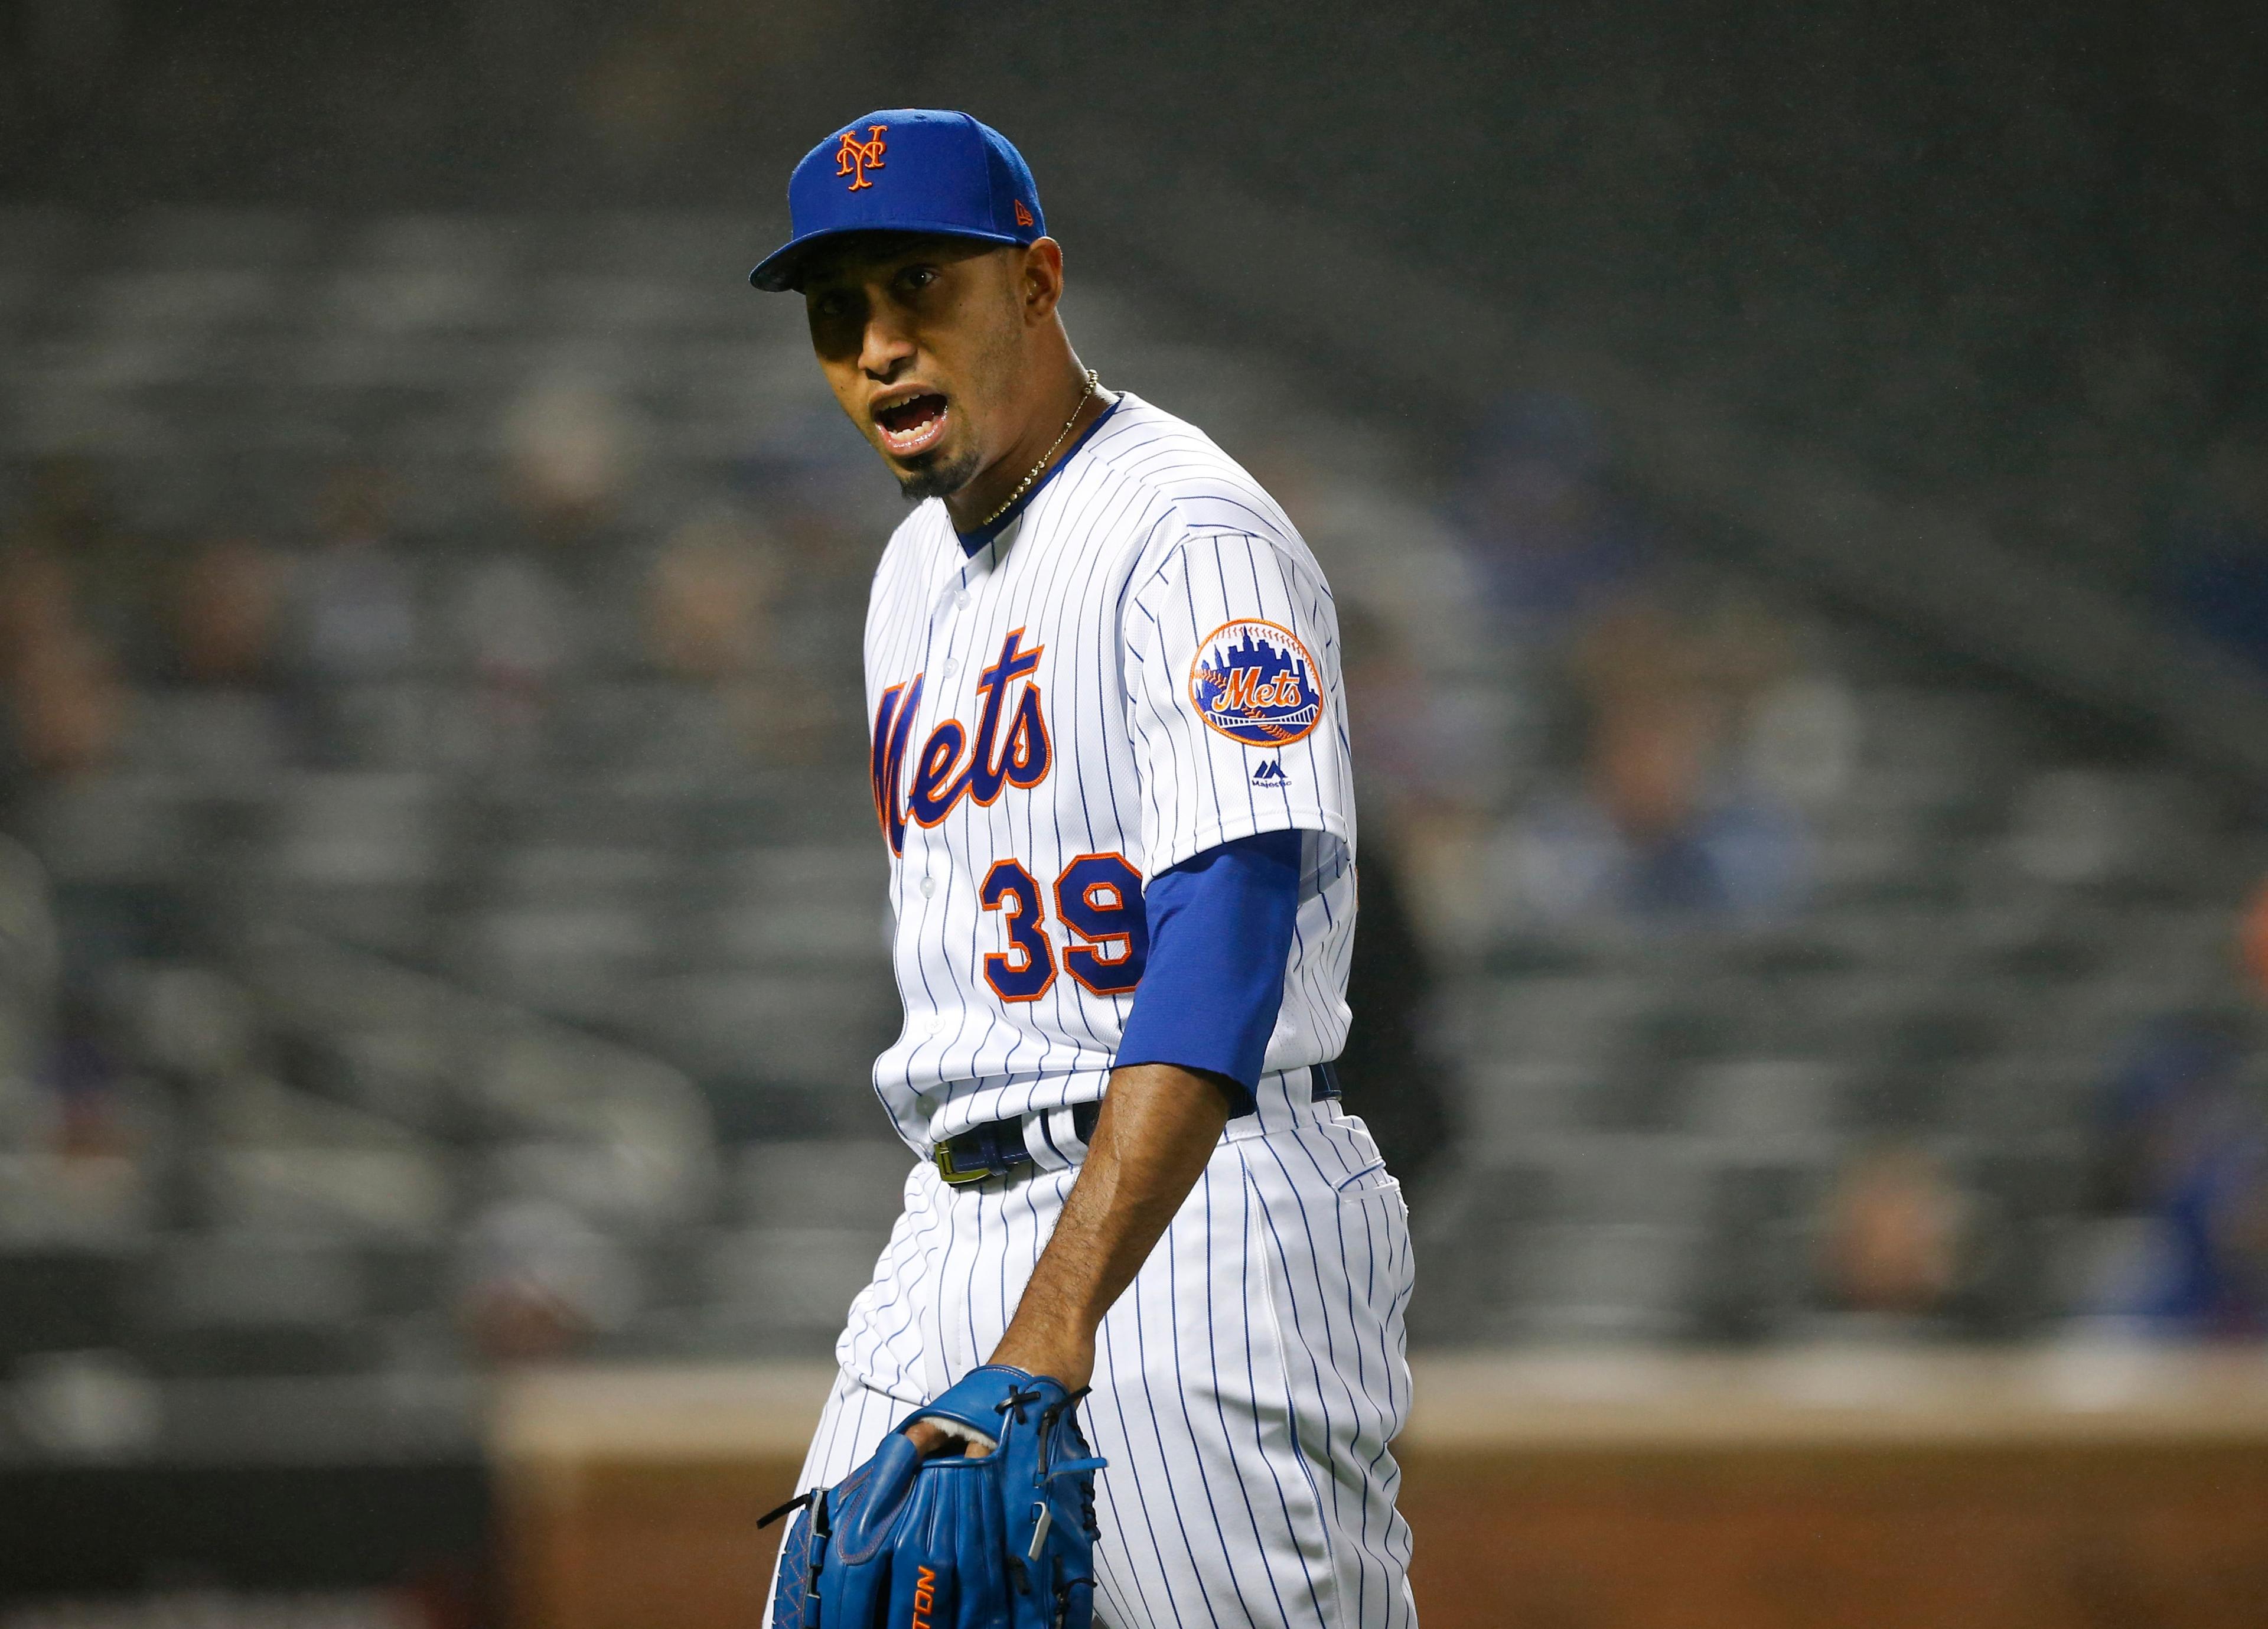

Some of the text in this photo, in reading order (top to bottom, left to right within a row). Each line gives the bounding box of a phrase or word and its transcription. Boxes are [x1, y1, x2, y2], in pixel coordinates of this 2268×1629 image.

[836, 125, 888, 191] NY
[1211, 666, 1302, 712] Mets
[979, 852, 1148, 1002] 39
